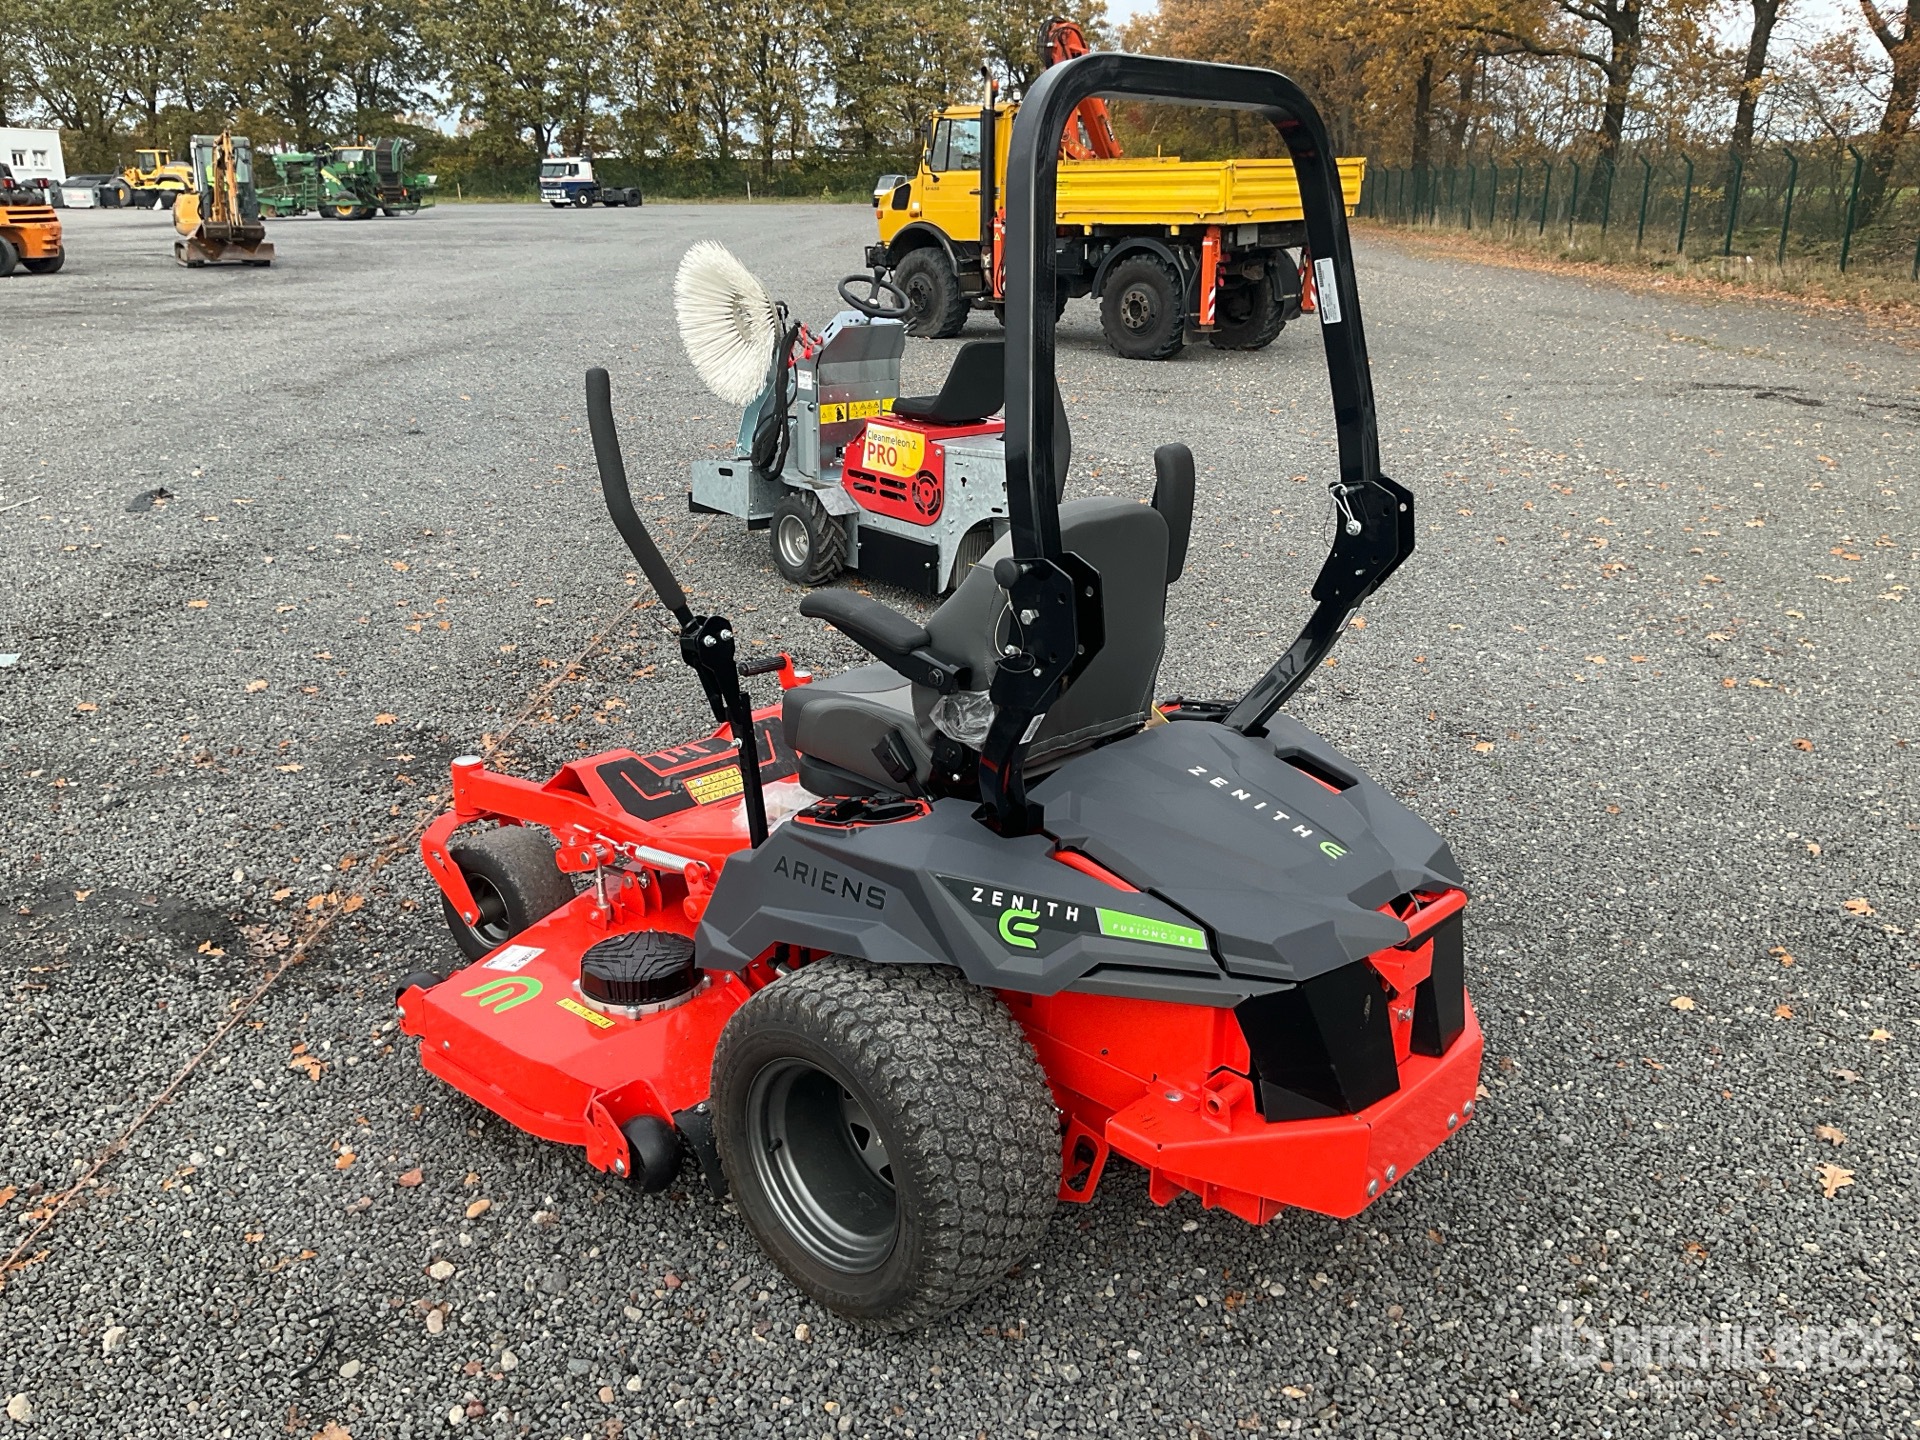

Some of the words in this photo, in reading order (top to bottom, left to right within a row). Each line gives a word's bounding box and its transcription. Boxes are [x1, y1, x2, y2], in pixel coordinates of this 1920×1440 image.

[867, 441, 898, 468] PRO
[868, 430, 911, 449] Cleanmeleon
[911, 440, 917, 450] 2
[1187, 765, 1313, 838] ZENITH
[773, 855, 887, 910] ARIENS
[971, 887, 1079, 922] ZENITH
[1112, 923, 1194, 945] FUSIONCORE
